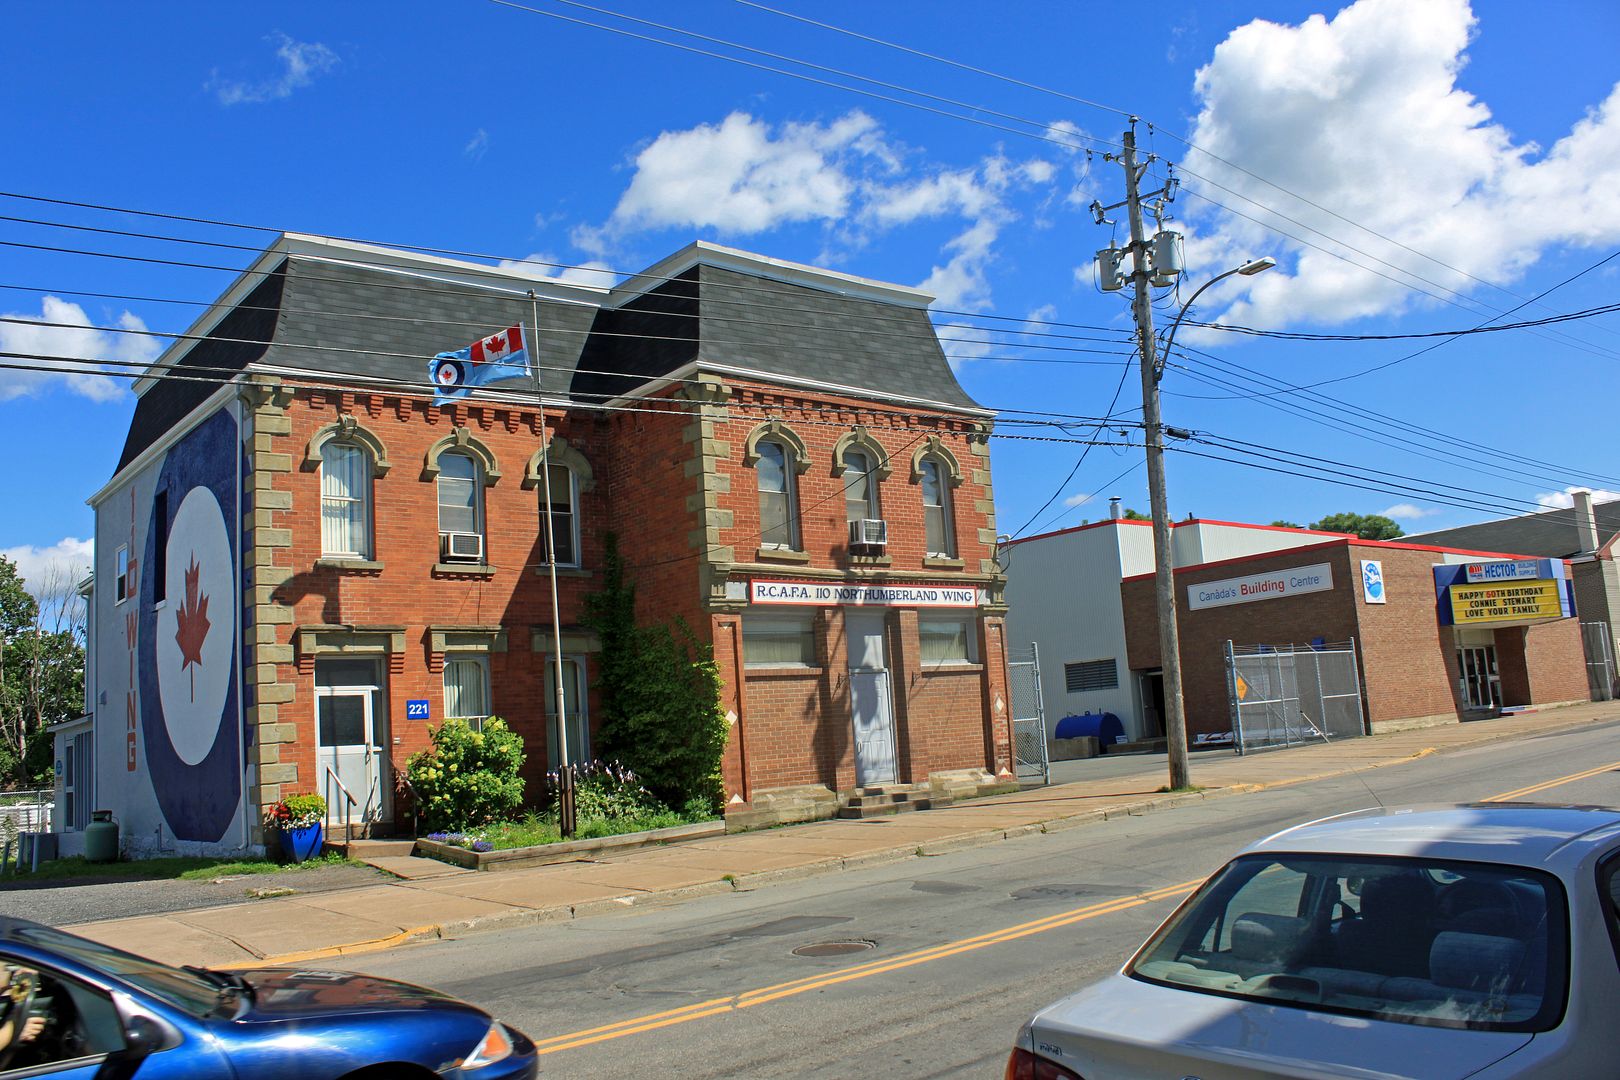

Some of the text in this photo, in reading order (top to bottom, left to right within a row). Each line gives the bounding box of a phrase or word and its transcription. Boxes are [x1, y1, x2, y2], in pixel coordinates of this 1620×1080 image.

[1484, 564, 1517, 578] HECTOR
[757, 586, 973, 602] R.C.A.F.A. 110 NORTHUMBERLAND WING
[1199, 575, 1320, 602] Canada's Building Centre
[1459, 591, 1484, 600] HAPPY
[1507, 587, 1544, 597] BIRTHDAY
[1470, 597, 1536, 608] CONNIE STEWART
[1465, 605, 1540, 618] LOVE YOUR FAMILY
[126, 609, 138, 772] WING
[408, 703, 428, 715] 221
